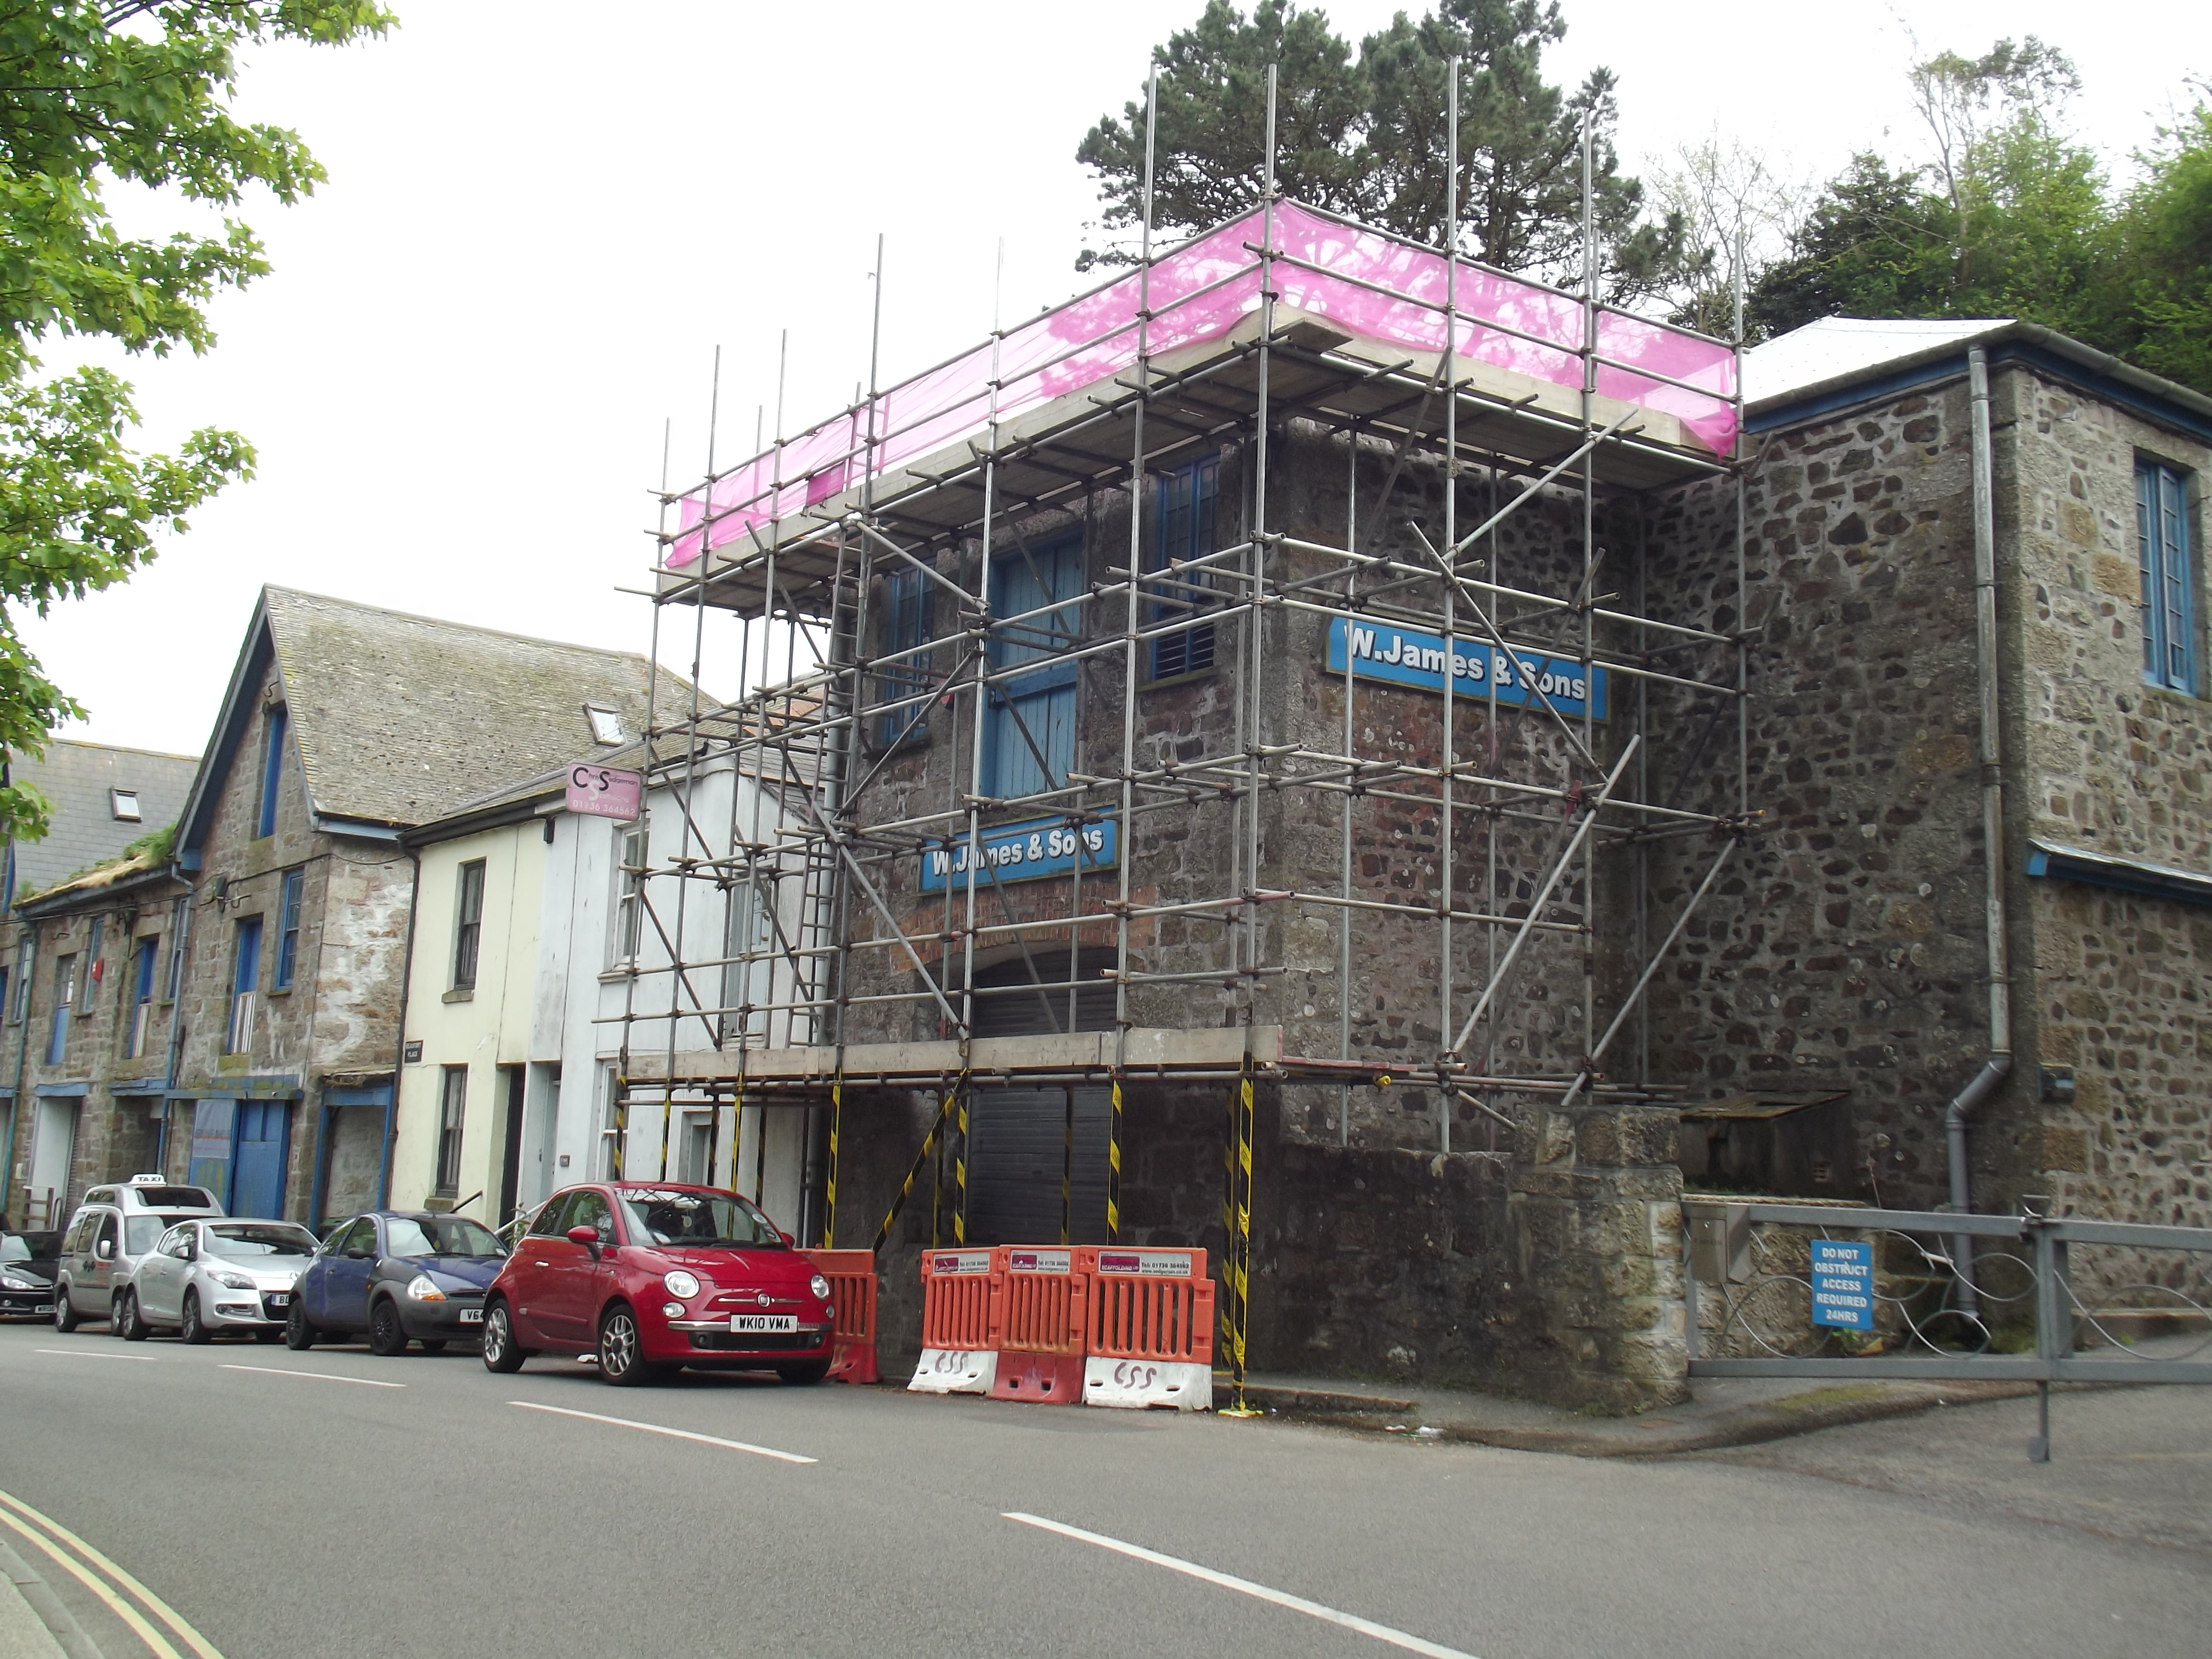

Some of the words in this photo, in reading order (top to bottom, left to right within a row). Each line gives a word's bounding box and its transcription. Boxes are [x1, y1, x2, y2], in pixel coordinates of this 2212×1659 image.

[1343, 625, 1485, 681] W.James
[1495, 656, 1512, 686] &
[1519, 661, 1586, 700] Sons
[598, 771, 638, 791] Sedgeman
[573, 800, 600, 810] 01736
[603, 804, 636, 816] 364562
[1028, 834, 1044, 860] &
[1821, 1247, 1836, 1259] DO
[1837, 1248, 1859, 1260] NOT
[1814, 1262, 1868, 1277] OBSTRUCT
[1821, 1278, 1862, 1292] ACCESS
[1816, 1292, 1867, 1308] REQUIRED
[740, 1317, 765, 1329] WK10
[769, 1318, 790, 1329] VMA
[1825, 1309, 1859, 1323] 24HRS
[935, 1351, 969, 1375] CSS
[1114, 1362, 1157, 1389] CSS
